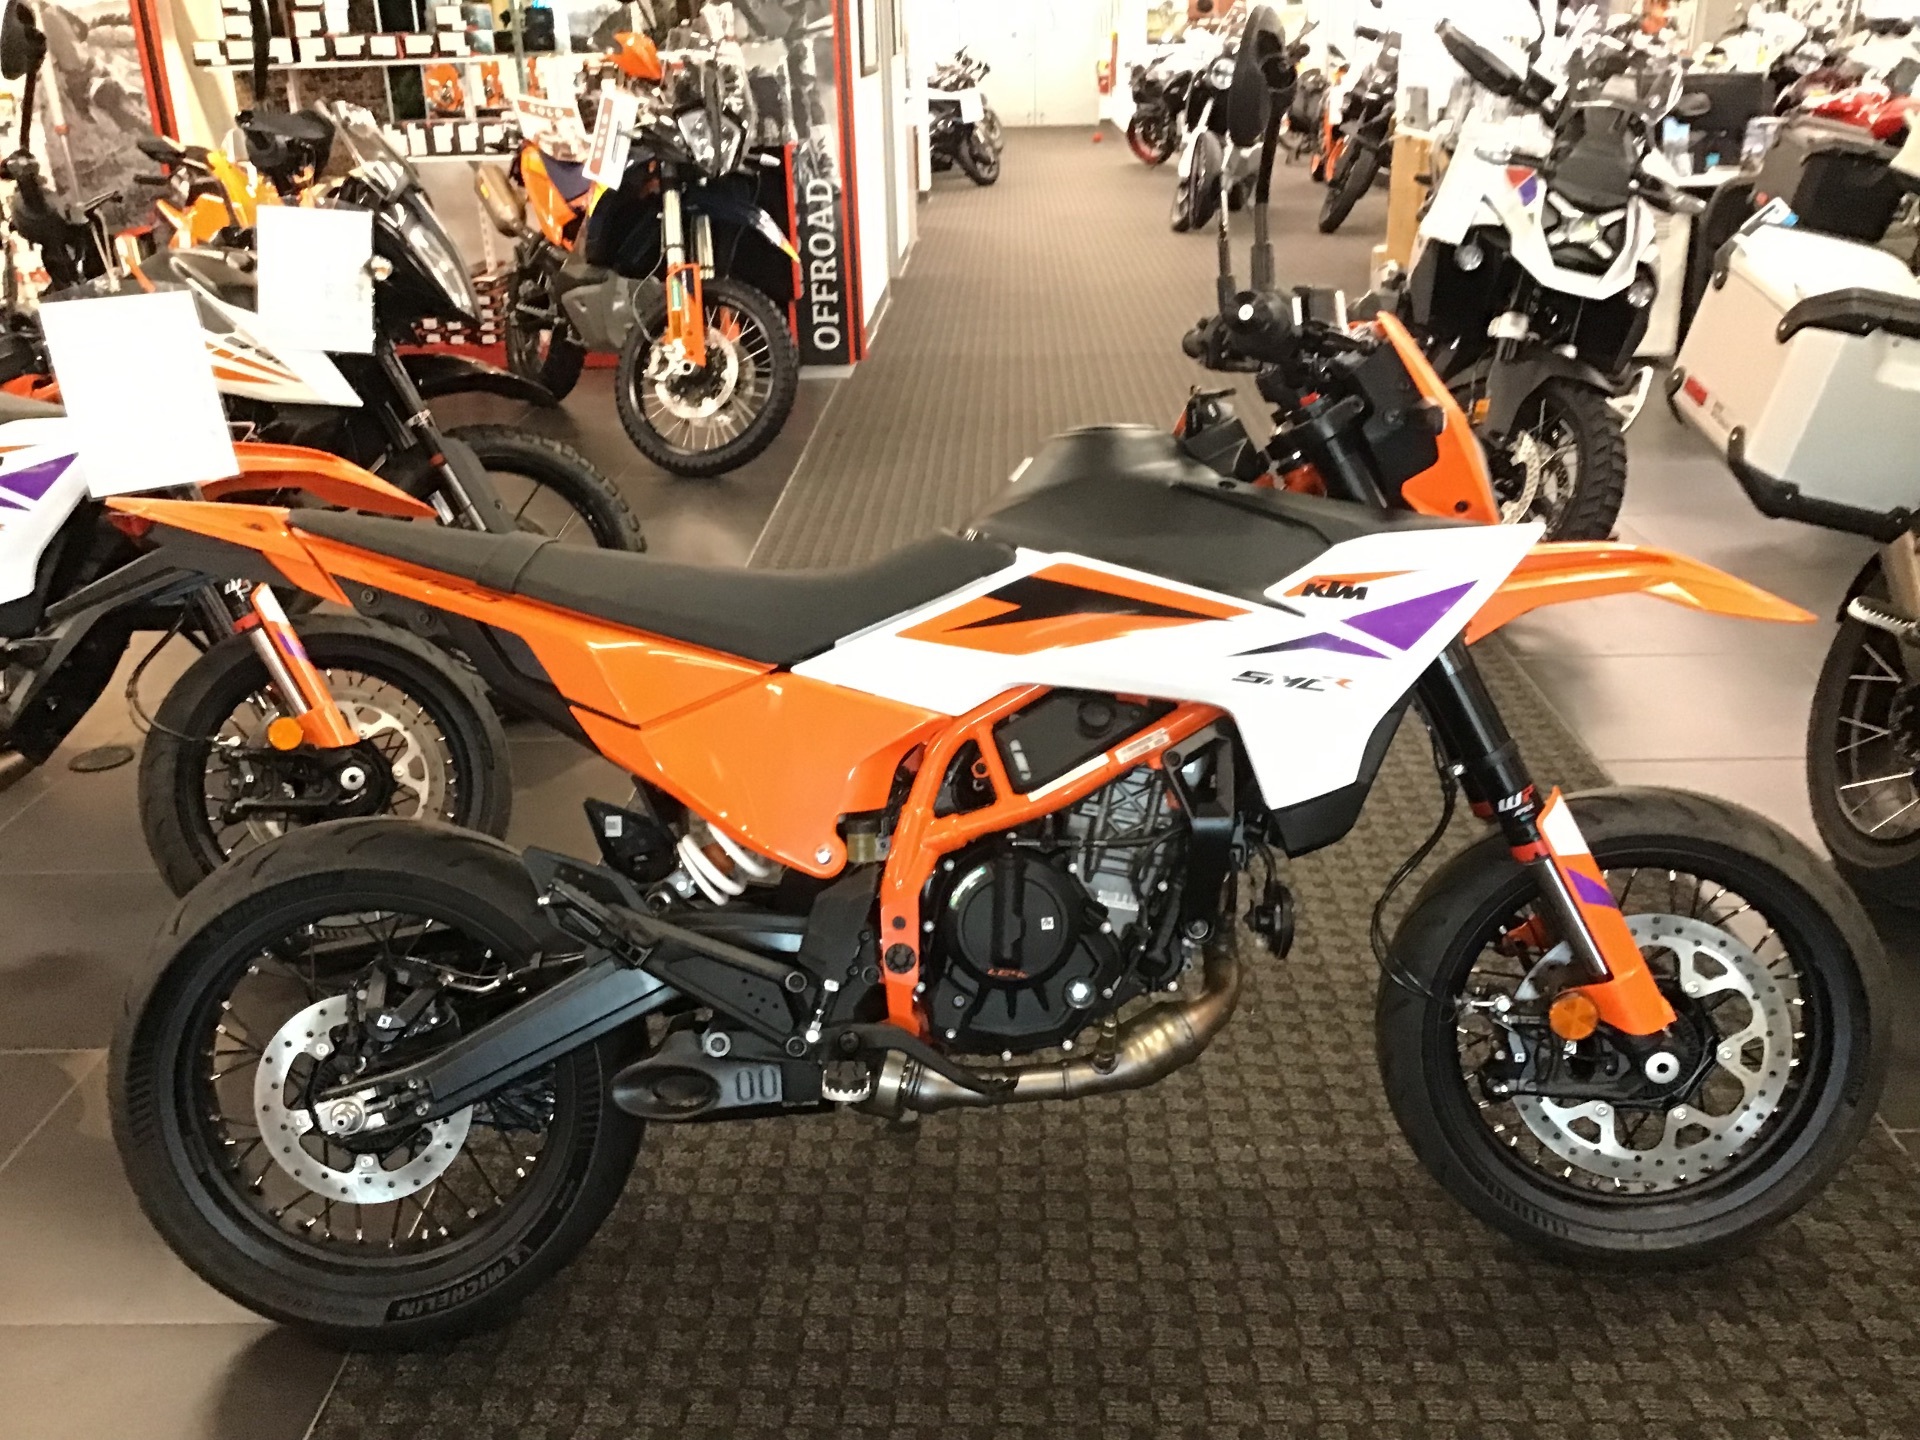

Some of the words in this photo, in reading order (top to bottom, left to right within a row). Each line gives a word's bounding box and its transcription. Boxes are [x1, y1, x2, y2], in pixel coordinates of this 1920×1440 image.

[806, 178, 841, 351] OFFROAD
[1301, 581, 1368, 600] KTM
[397, 1258, 507, 1318] MICHELIN
